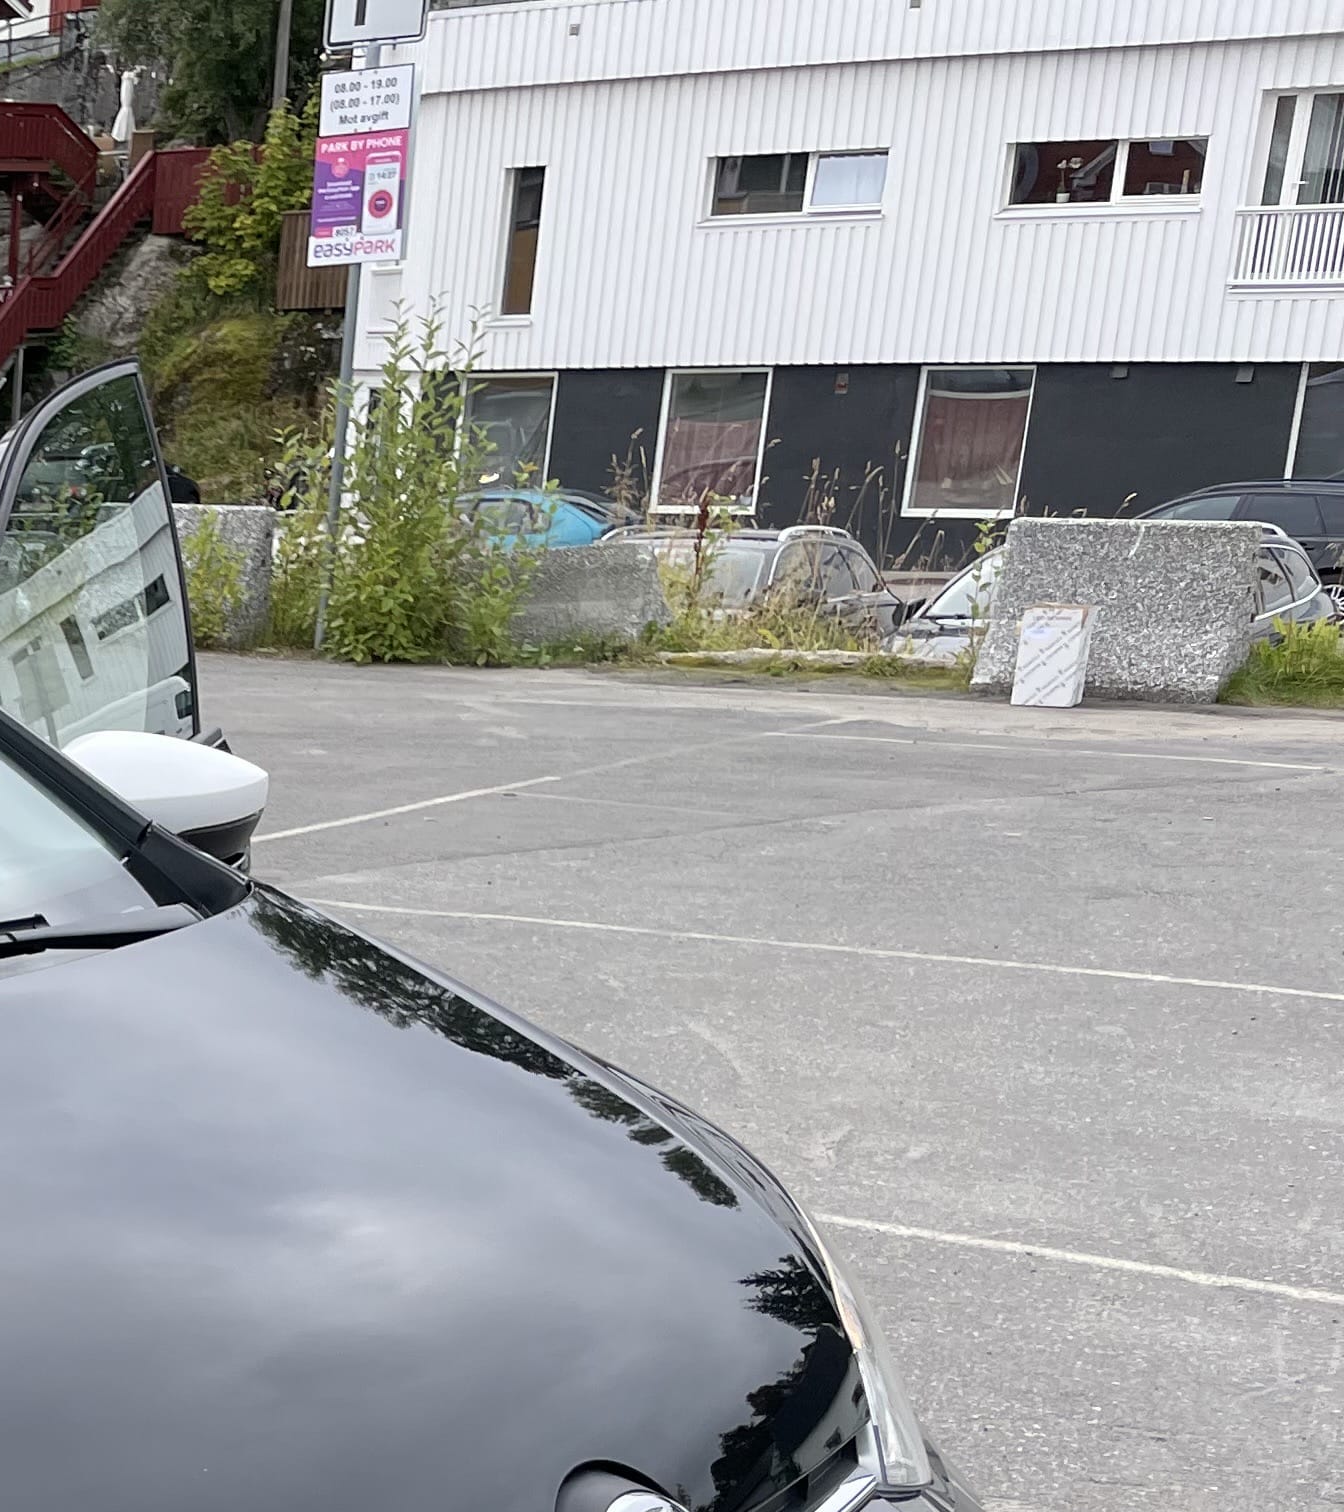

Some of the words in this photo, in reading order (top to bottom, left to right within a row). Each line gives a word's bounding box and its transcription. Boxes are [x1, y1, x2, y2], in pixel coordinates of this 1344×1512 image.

[334, 81, 362, 94] 08.00
[371, 77, 398, 90] 19.00
[330, 97, 360, 112] (08.00
[370, 93, 400, 106] 17.00)
[339, 114, 358, 125] Mot
[360, 111, 389, 124] avgift
[321, 141, 349, 154] PARK
[350, 139, 365, 152] BY
[366, 135, 403, 149] PHONE
